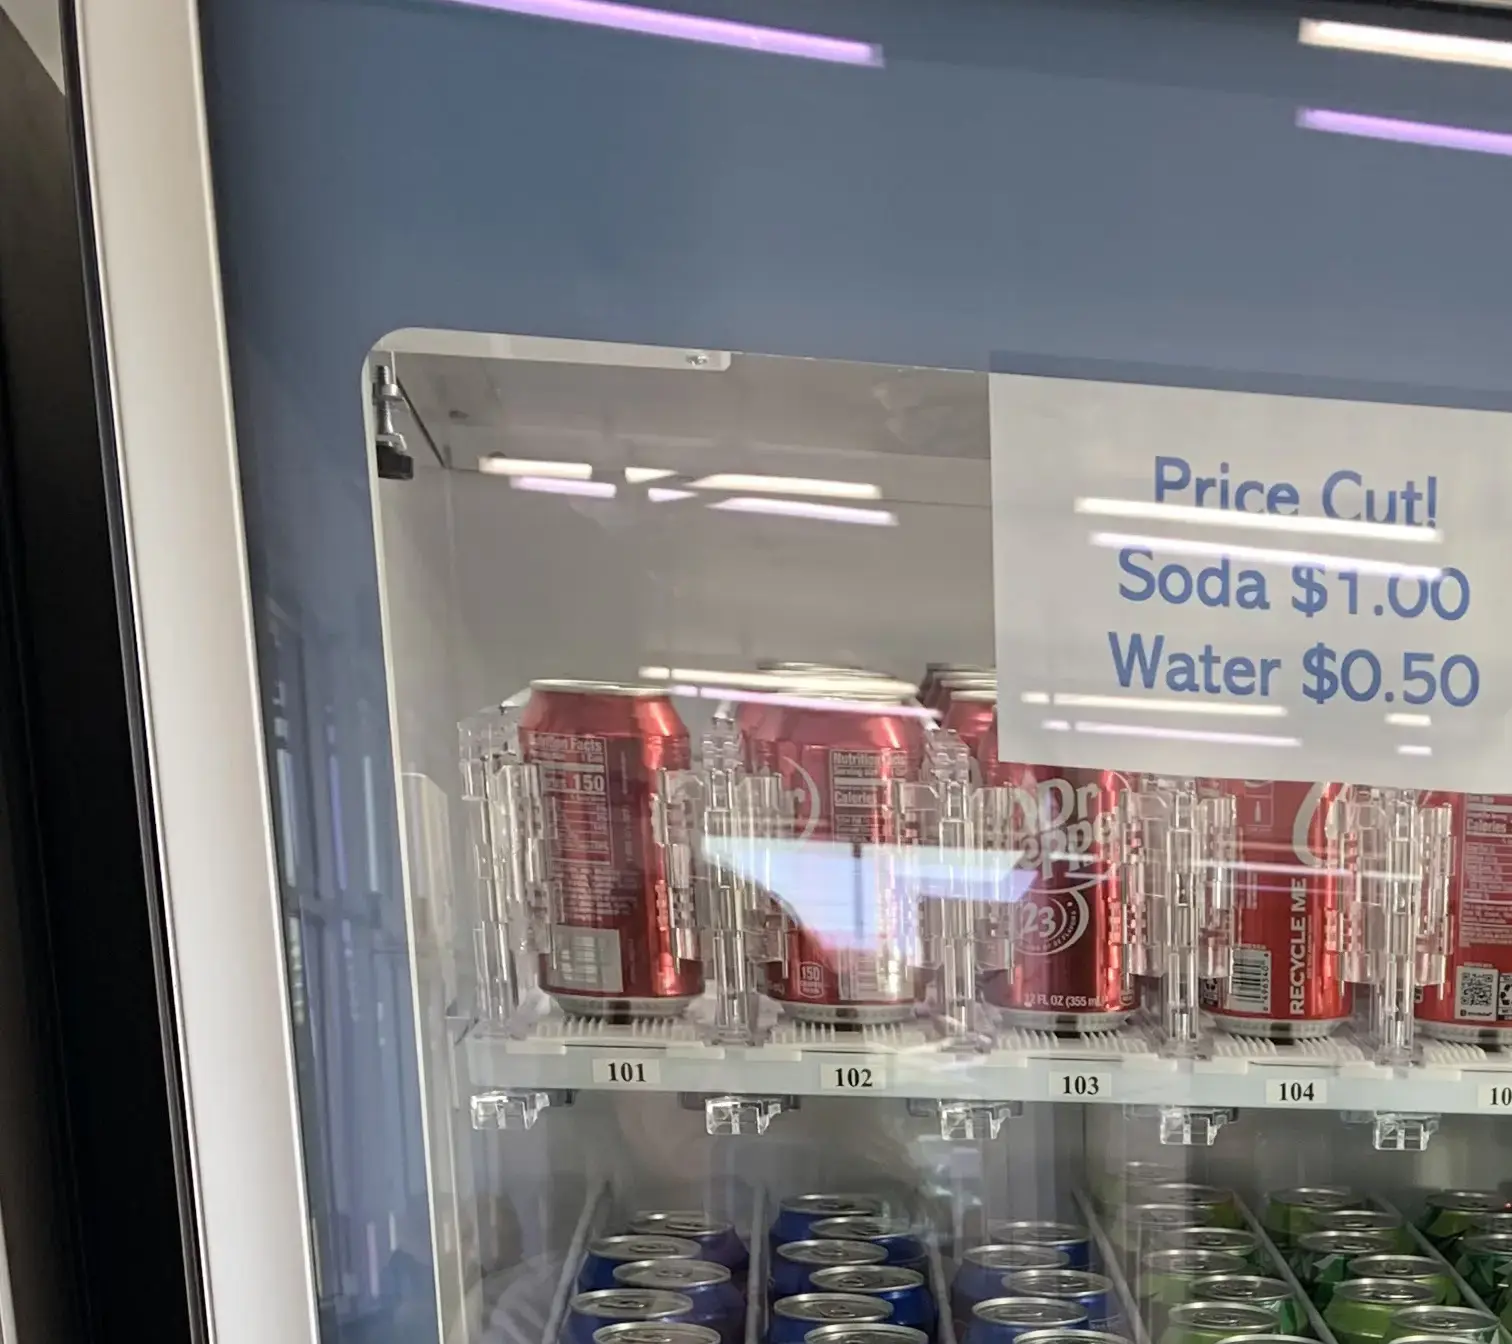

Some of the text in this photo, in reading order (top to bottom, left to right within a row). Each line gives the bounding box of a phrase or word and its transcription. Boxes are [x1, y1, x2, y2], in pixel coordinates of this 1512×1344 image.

[1153, 455, 1439, 530] Price Cut!
[1117, 546, 1472, 621] Soda $1.00
[1108, 631, 1481, 708] Water $0.50
[573, 774, 605, 792] 150
[1037, 778, 1103, 829] Dr
[1022, 902, 1056, 938] 23
[1289, 877, 1307, 1016] RECYCLE ME
[607, 1060, 647, 1083] 101
[834, 1067, 874, 1088] 102
[1061, 1075, 1100, 1095] 103
[1278, 1081, 1315, 1101] 104
